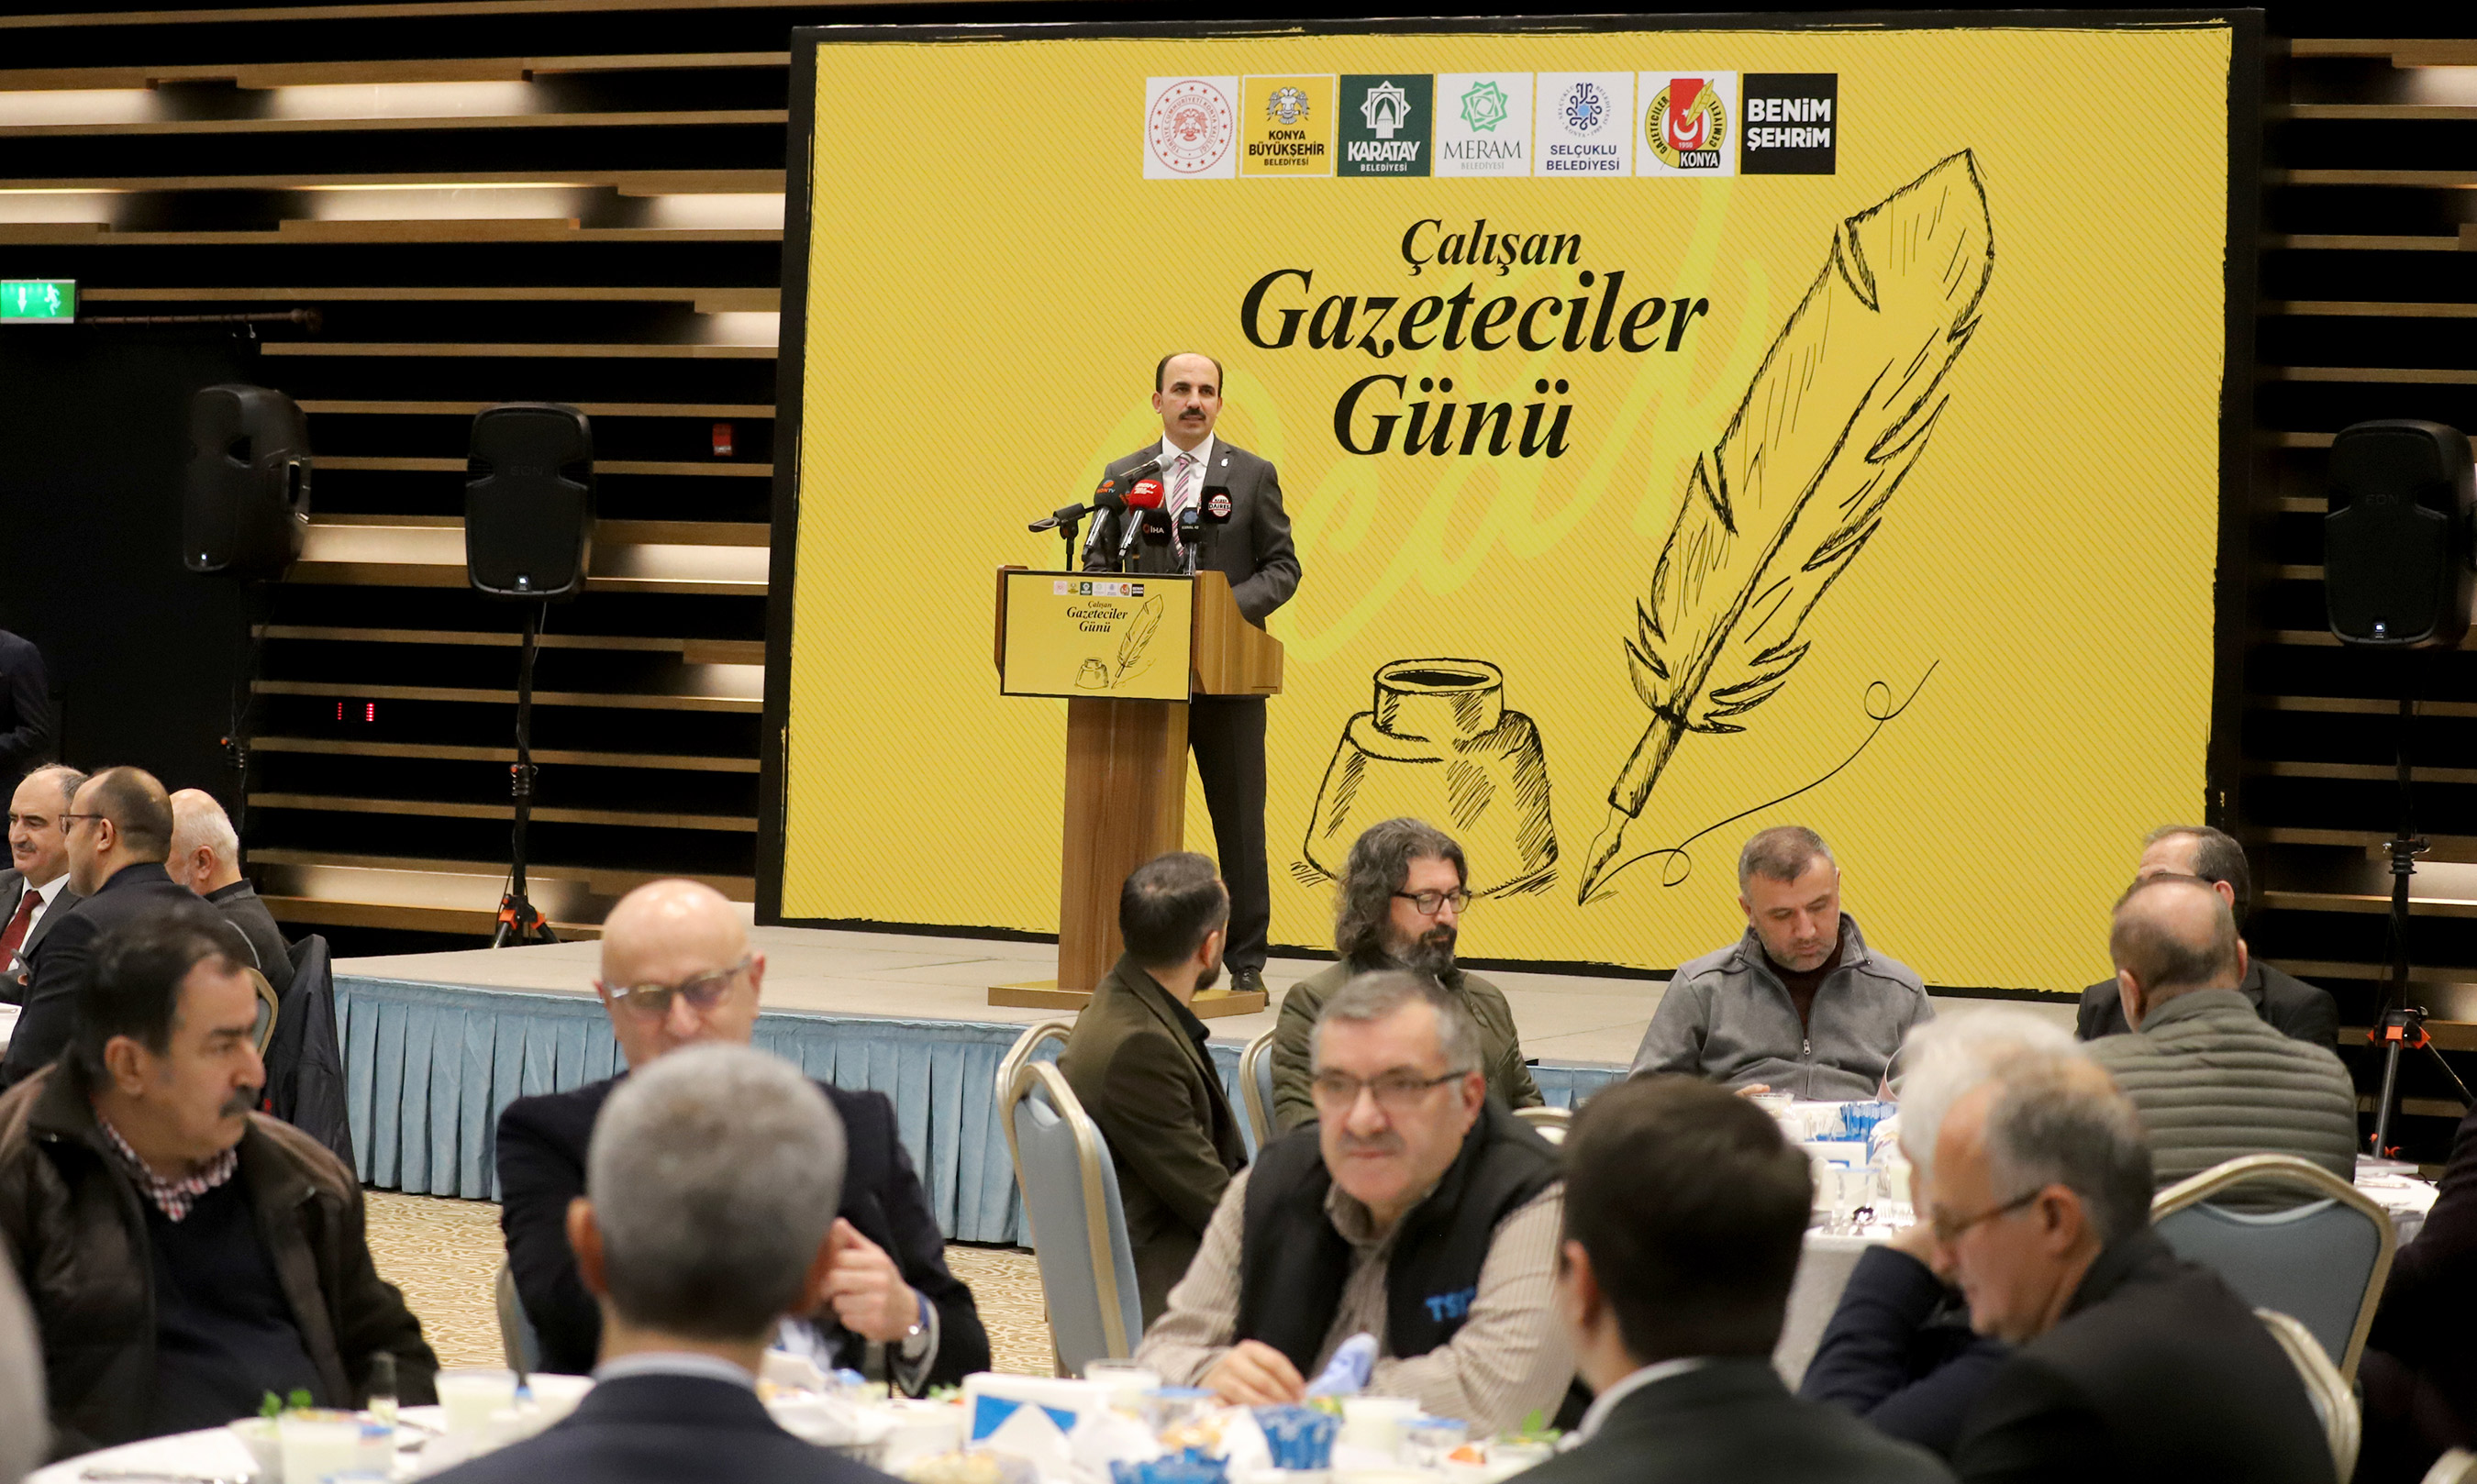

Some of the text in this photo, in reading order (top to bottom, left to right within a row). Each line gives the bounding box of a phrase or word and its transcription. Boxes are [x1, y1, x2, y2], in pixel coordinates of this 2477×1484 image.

[1650, 95, 1670, 154] GAZETECİLER
[1709, 100, 1723, 148] CEMİYETİ
[1268, 130, 1306, 140] KONYA
[1249, 141, 1325, 157] BÜYÜKŞEHİR
[1348, 140, 1421, 161] KARATAY
[1443, 140, 1523, 160] MERAM
[1550, 144, 1616, 159] SELÇUKLU
[1263, 158, 1309, 166] BELEDİYESİ
[1360, 162, 1407, 172] BELEDİYESİ
[1461, 161, 1505, 170] BELEDİYESİ
[1546, 157, 1620, 171] BELEDİYESİ
[1680, 150, 1719, 168] KONYA
[1400, 217, 1583, 277] Çalışan
[1240, 268, 1710, 359] Gazeteciler
[1333, 373, 1574, 459] Günü
[1066, 606, 1128, 619] Gazeteciler
[1079, 620, 1111, 633] Günü
